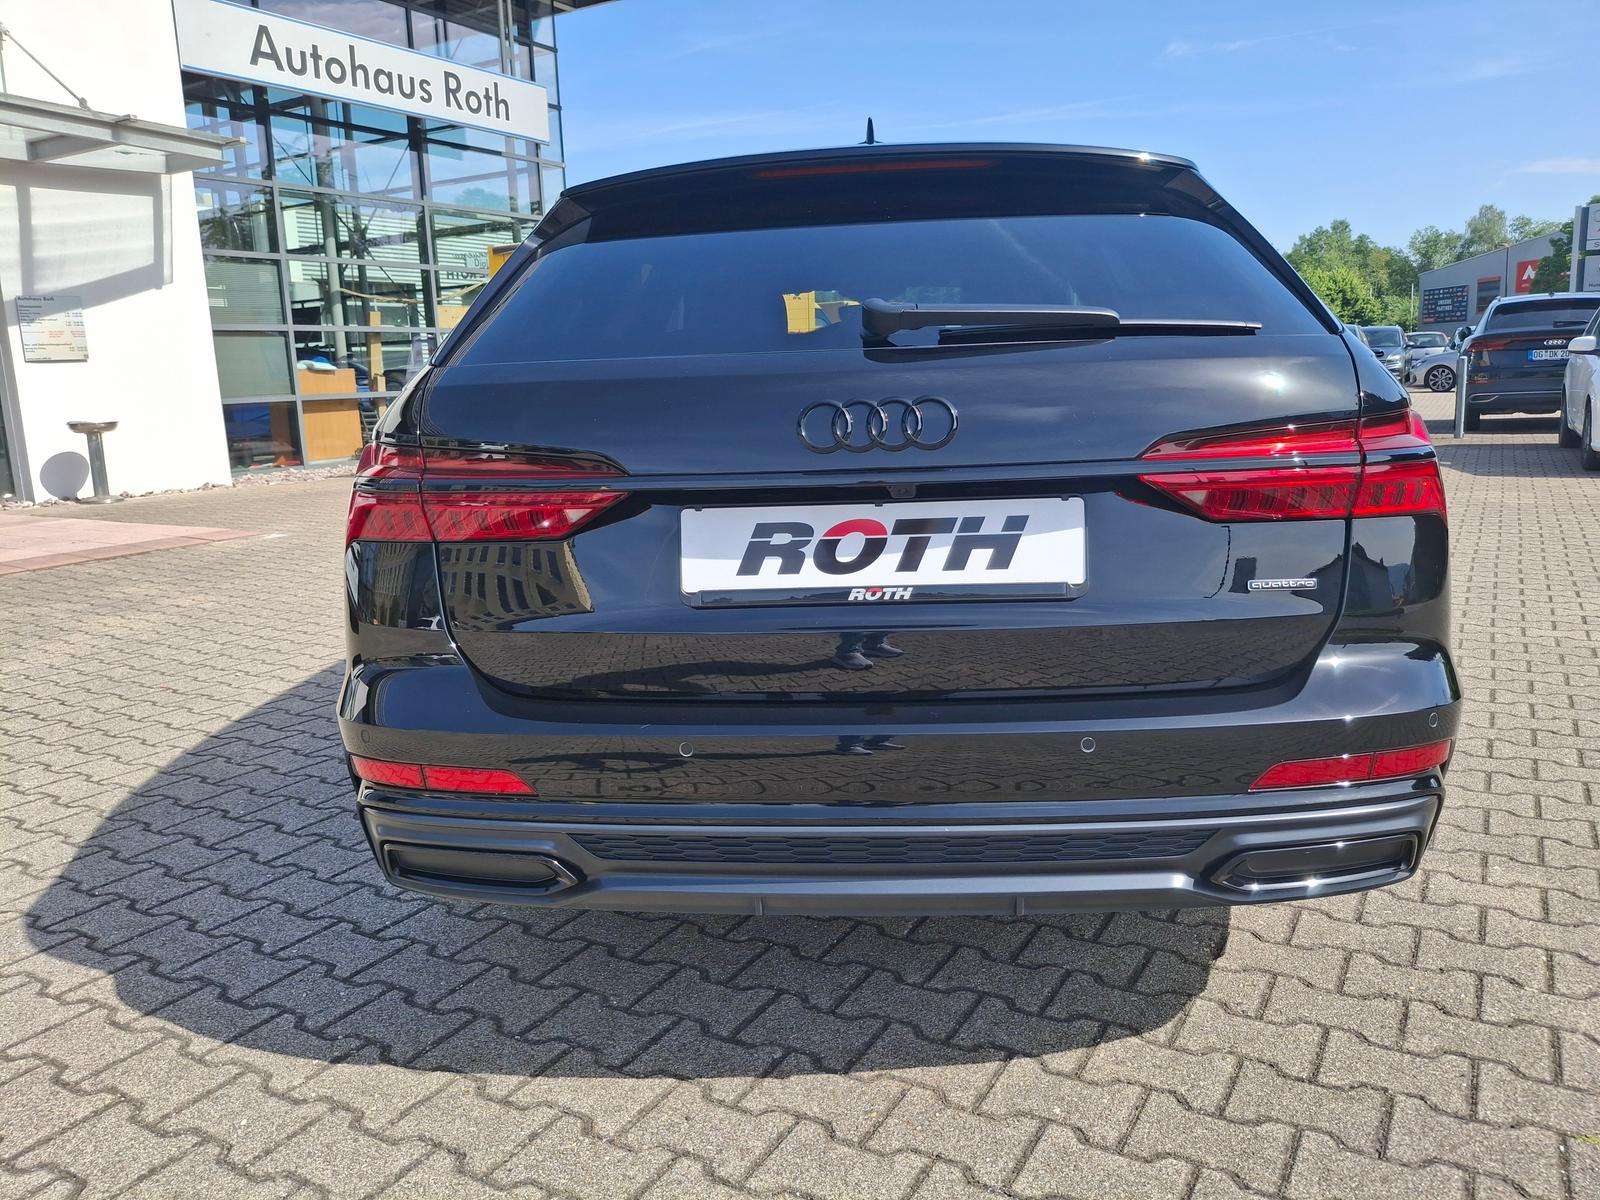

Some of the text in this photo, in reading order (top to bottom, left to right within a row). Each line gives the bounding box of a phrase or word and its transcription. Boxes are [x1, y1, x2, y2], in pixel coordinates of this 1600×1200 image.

[250, 24, 511, 122] Autohaus Roth
[735, 514, 1030, 576] ROTH
[848, 586, 913, 601] ROTH
[1250, 580, 1315, 589] quattro
